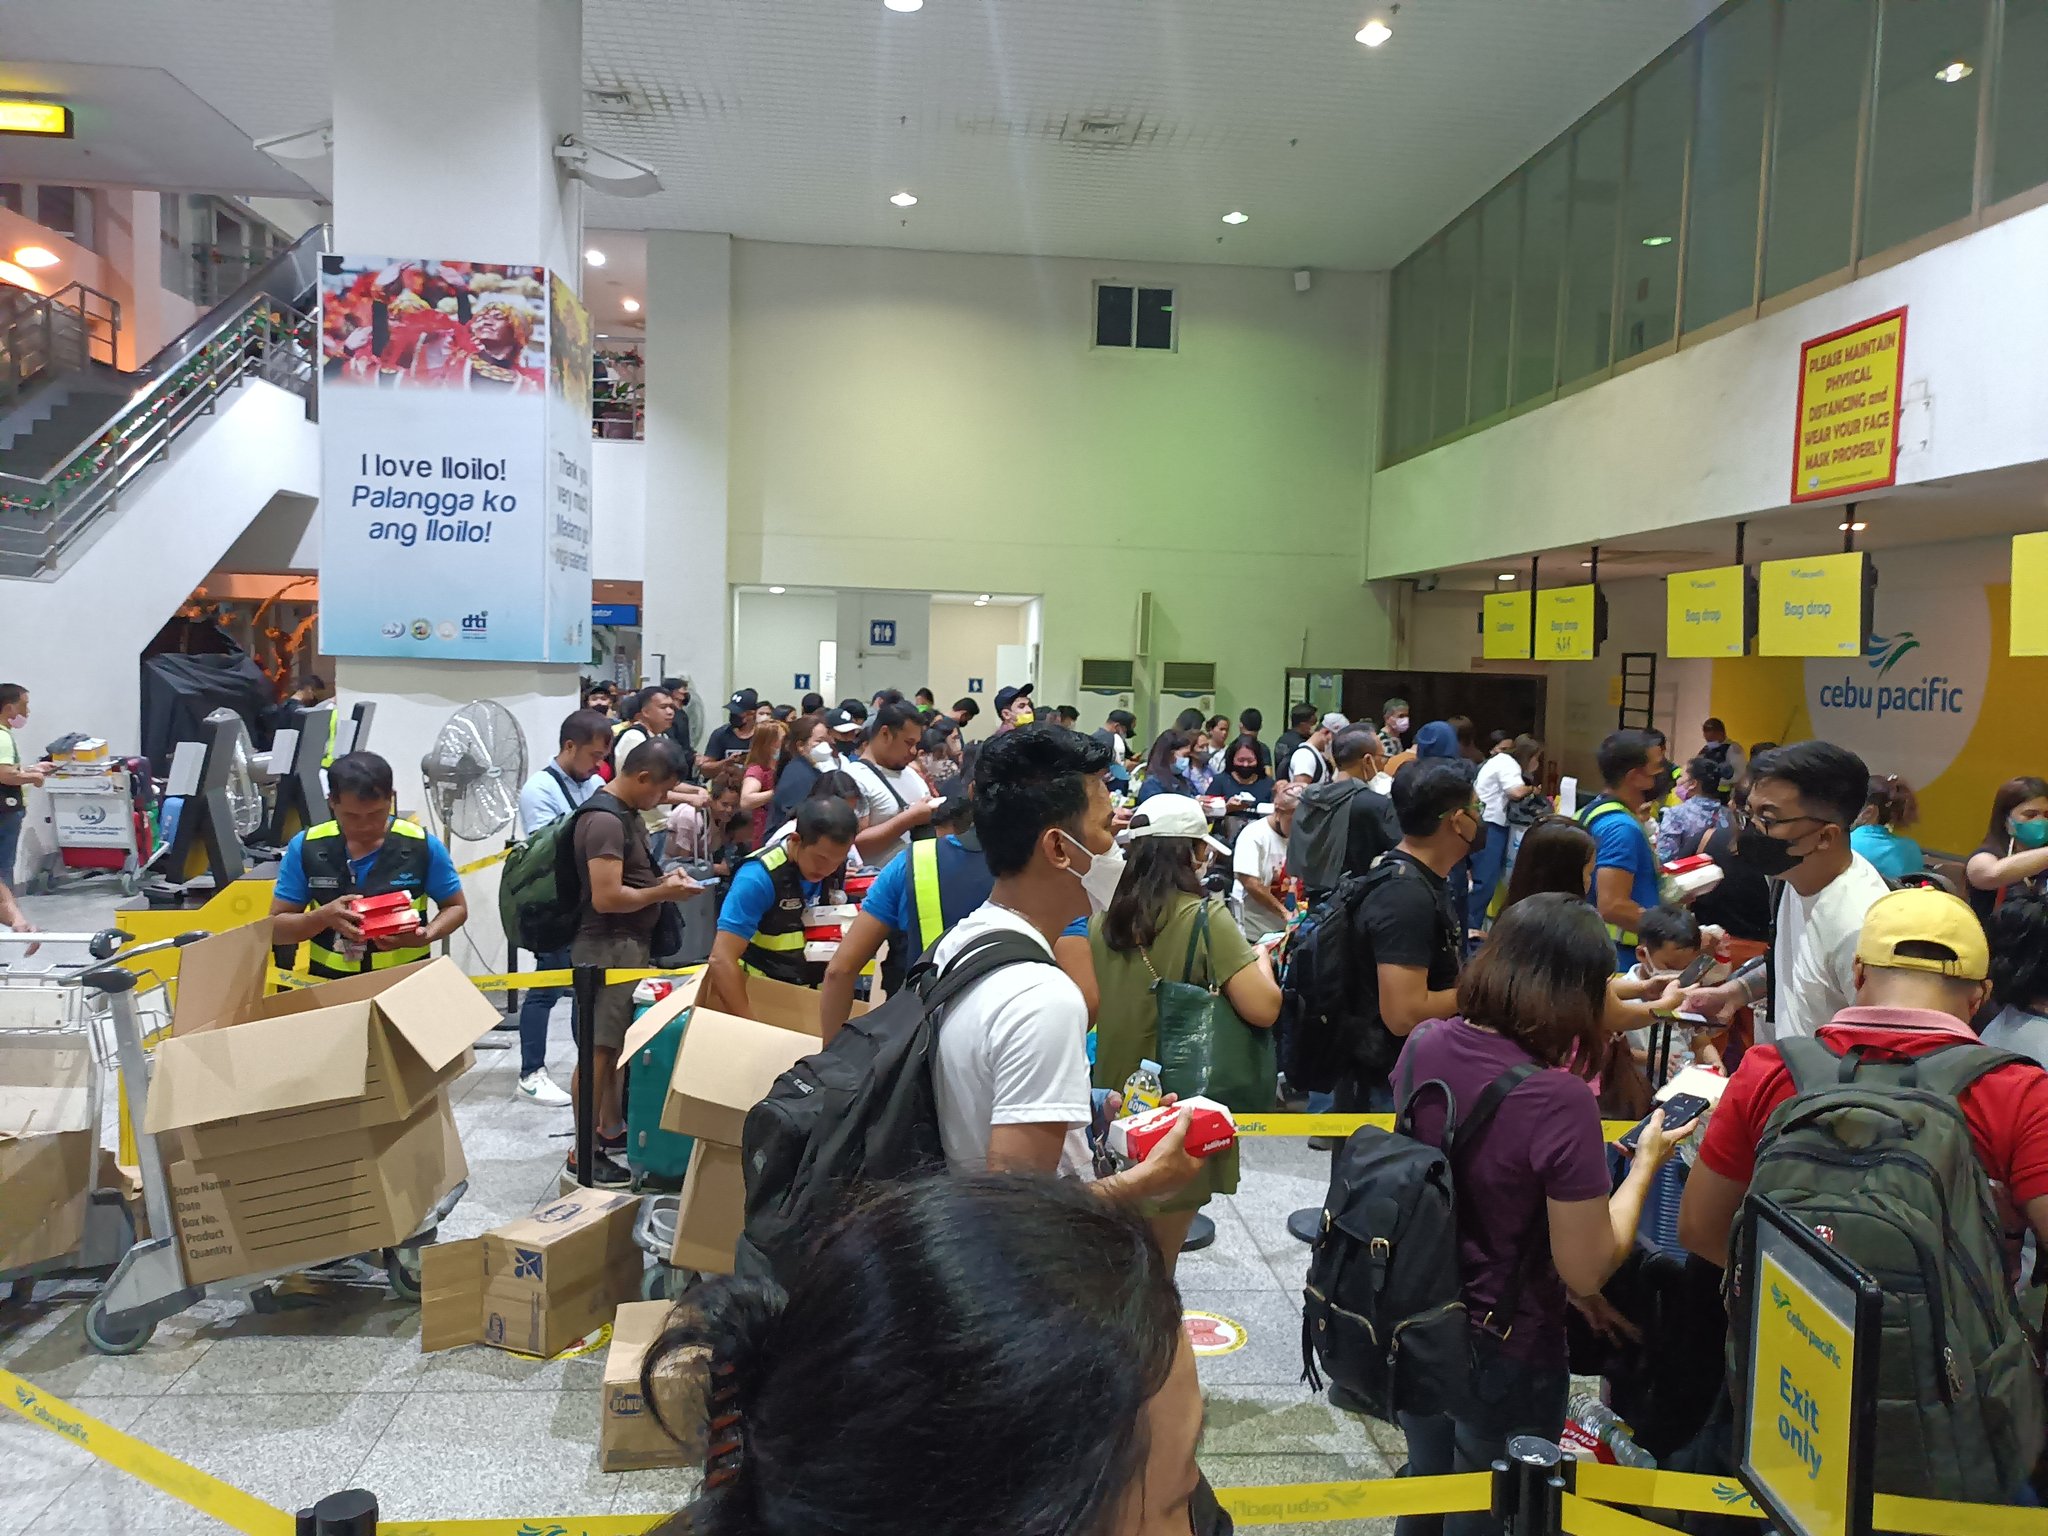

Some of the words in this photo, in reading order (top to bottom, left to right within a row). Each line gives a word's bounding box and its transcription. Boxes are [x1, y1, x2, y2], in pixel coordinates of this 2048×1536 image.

[1809, 349, 1843, 374] PLEASE
[1844, 331, 1896, 363] MAINTAIN
[1825, 365, 1873, 393] PHYSICAL
[1808, 391, 1866, 422] DISTANCING
[1804, 425, 1832, 447] WEAR
[1833, 418, 1861, 439] YOUR
[1862, 410, 1890, 432] FACE
[375, 453, 432, 478] love
[1805, 450, 1831, 471] MASK
[1832, 438, 1886, 464] PROPERLY
[351, 484, 474, 517] Palangga
[482, 489, 517, 513] ko
[368, 520, 417, 547] ang
[1685, 608, 1701, 625] Bag
[1784, 601, 1804, 620] Bag
[1807, 602, 1832, 618] drop
[1820, 676, 1872, 709] cebu
[1876, 677, 1963, 719] pacific
[1234, 1121, 1267, 1132] acific
[201, 1179, 231, 1192] Name
[178, 1202, 200, 1213] Date
[181, 1217, 200, 1229] Box
[201, 1215, 219, 1224] No.
[186, 1229, 224, 1243] Product
[190, 1245, 233, 1259] Quantity
[1786, 1309, 1809, 1338] cebu
[1809, 1329, 1842, 1369] pacific
[1780, 1364, 1819, 1434] Exit
[1778, 1414, 1822, 1480] only
